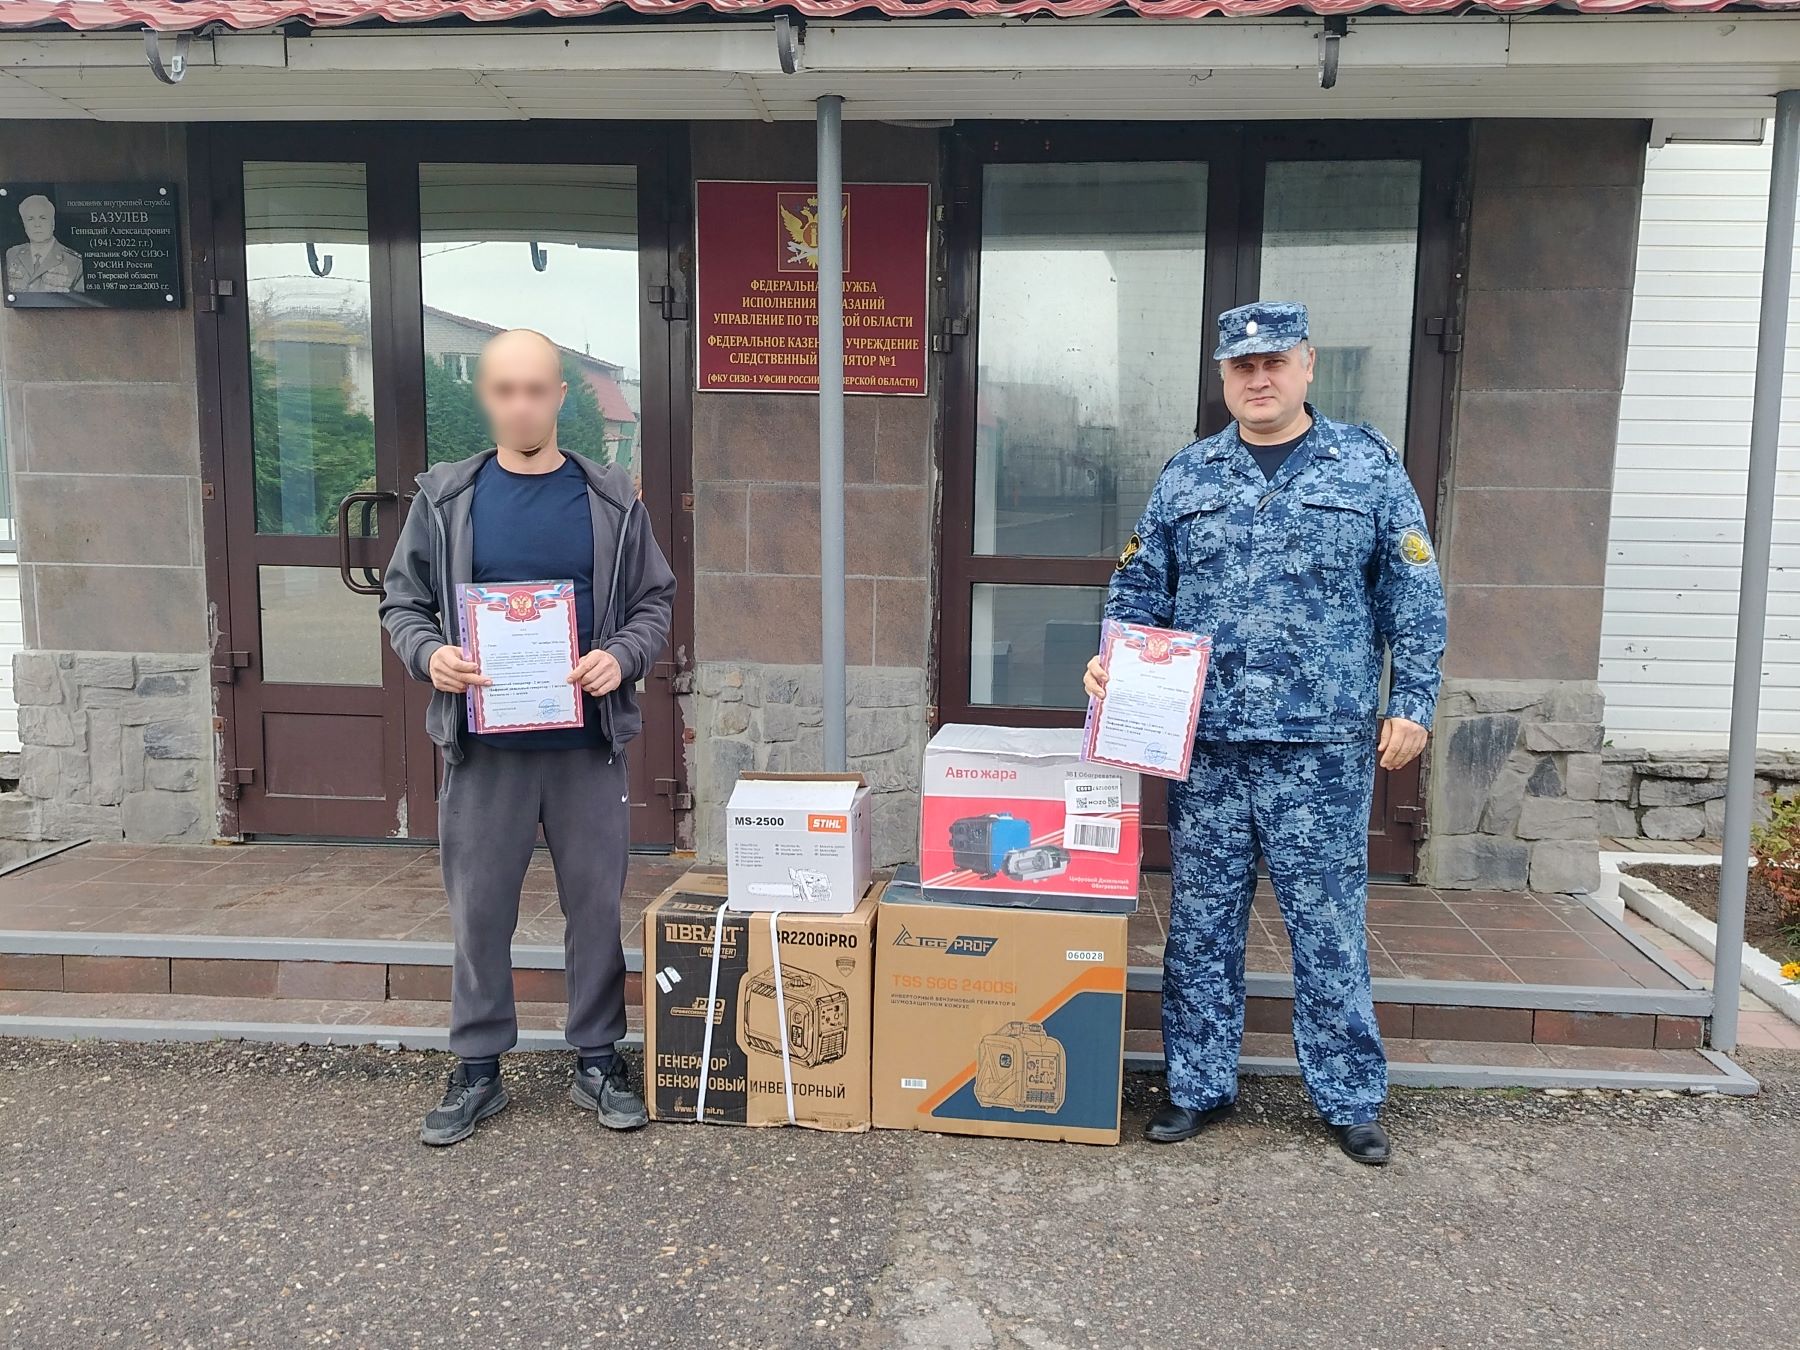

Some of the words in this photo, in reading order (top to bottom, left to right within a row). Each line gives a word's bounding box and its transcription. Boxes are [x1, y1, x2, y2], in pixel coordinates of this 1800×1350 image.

[90, 212, 149, 223] БАЗУЛЕВ
[71, 226, 108, 235] Геннадий
[110, 227, 171, 237] Александрович
[90, 239, 136, 248] (1941-2022
[121, 250, 139, 258] ФКУ
[141, 250, 169, 258] СИЗО-1
[93, 261, 124, 269] УФСИН
[126, 261, 153, 269] России
[97, 272, 129, 280] Тверской
[742, 297, 817, 309] ИСПОЛНЕНИЯ
[842, 296, 885, 310] АЗАНИЙ
[713, 313, 785, 326] УПРАВЛЕНИЕ
[786, 315, 803, 326] ПО
[863, 316, 913, 328] ОБЛАСТИ
[707, 335, 786, 348] ФЕДЕРАЛЬНОЕ
[846, 338, 919, 352] УЧРЕЖДЕНИЕ
[729, 351, 818, 366] СЛЕДСТВЕННЫЙ
[842, 355, 877, 366] ЛЯТОР
[879, 355, 897, 367] №1
[707, 373, 728, 384] (ФКУ
[729, 374, 757, 383] СИЗО-1
[758, 375, 787, 384] УФСИН
[788, 375, 820, 385] РОССИИ
[843, 376, 876, 385] ЕРСКОЙ
[877, 377, 918, 388] ОБЛАСТИ)
[945, 766, 978, 780] Авто
[980, 768, 1017, 782] жара
[735, 817, 784, 826] MS-2500
[813, 819, 841, 829] STIHL
[702, 947, 734, 955] INVTER
[954, 940, 992, 952] PROF
[1068, 952, 1103, 960] 060028
[892, 974, 922, 988] TSS
[927, 977, 958, 990] SGG
[962, 978, 1017, 994] 2400Si
[697, 1000, 722, 1009] PO
[891, 993, 934, 1001] ИНВЕРТОРНЫЙ
[935, 996, 975, 1004] БЕНЗИНОВЫЙ
[976, 999, 1009, 1007] ГЕНЕРАТОР
[891, 999, 943, 1007] ШУМОЗАЩИТНОМ
[657, 1054, 727, 1071] ГЕНЕРАОР
[657, 1074, 746, 1092] БЕНЗИОВЫЙ
[750, 1080, 845, 1099] ИНВЕТОРНЫЙ
